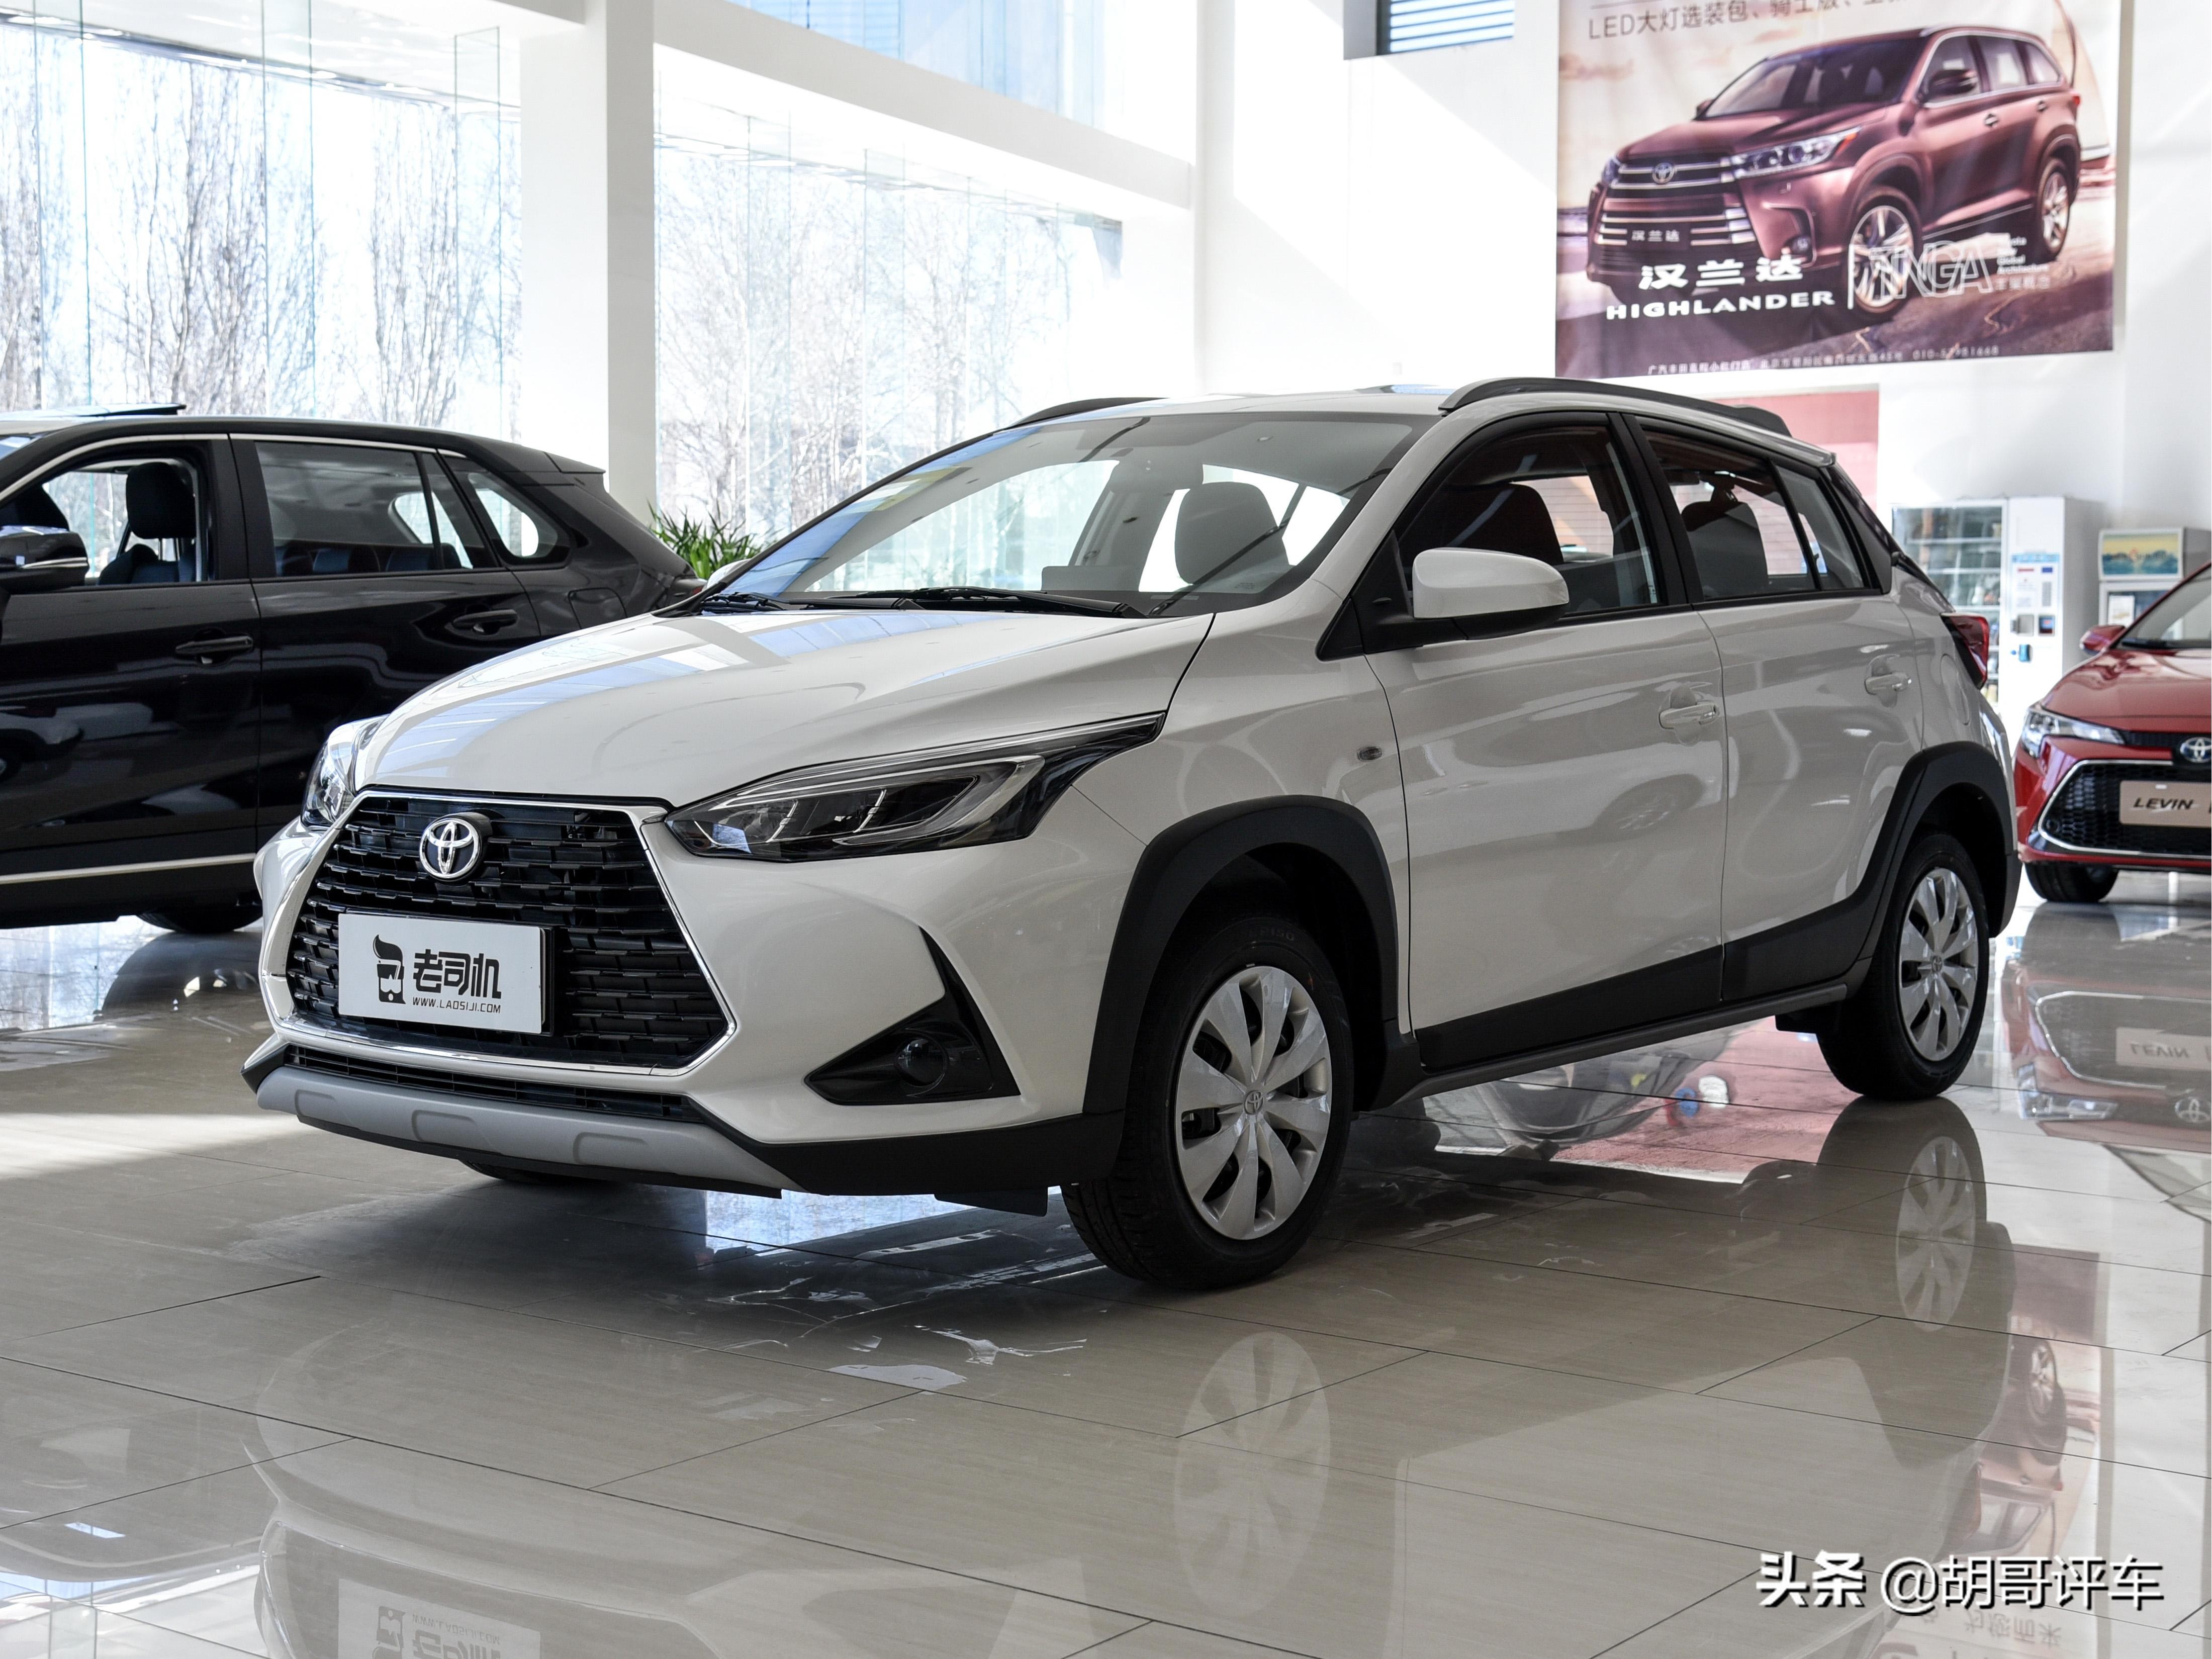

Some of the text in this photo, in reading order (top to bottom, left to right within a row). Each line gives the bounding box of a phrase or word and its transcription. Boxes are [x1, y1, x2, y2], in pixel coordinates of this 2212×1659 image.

[1631, 229, 1680, 242] 汉兰达
[1638, 253, 1803, 290] 汉兰达
[1607, 291, 1835, 320] HIGHLANDER
[2133, 797, 2194, 810] LEVIN
[413, 948, 502, 999] 老司机
[412, 996, 501, 1014] WWW.LAOSIJI.COM
